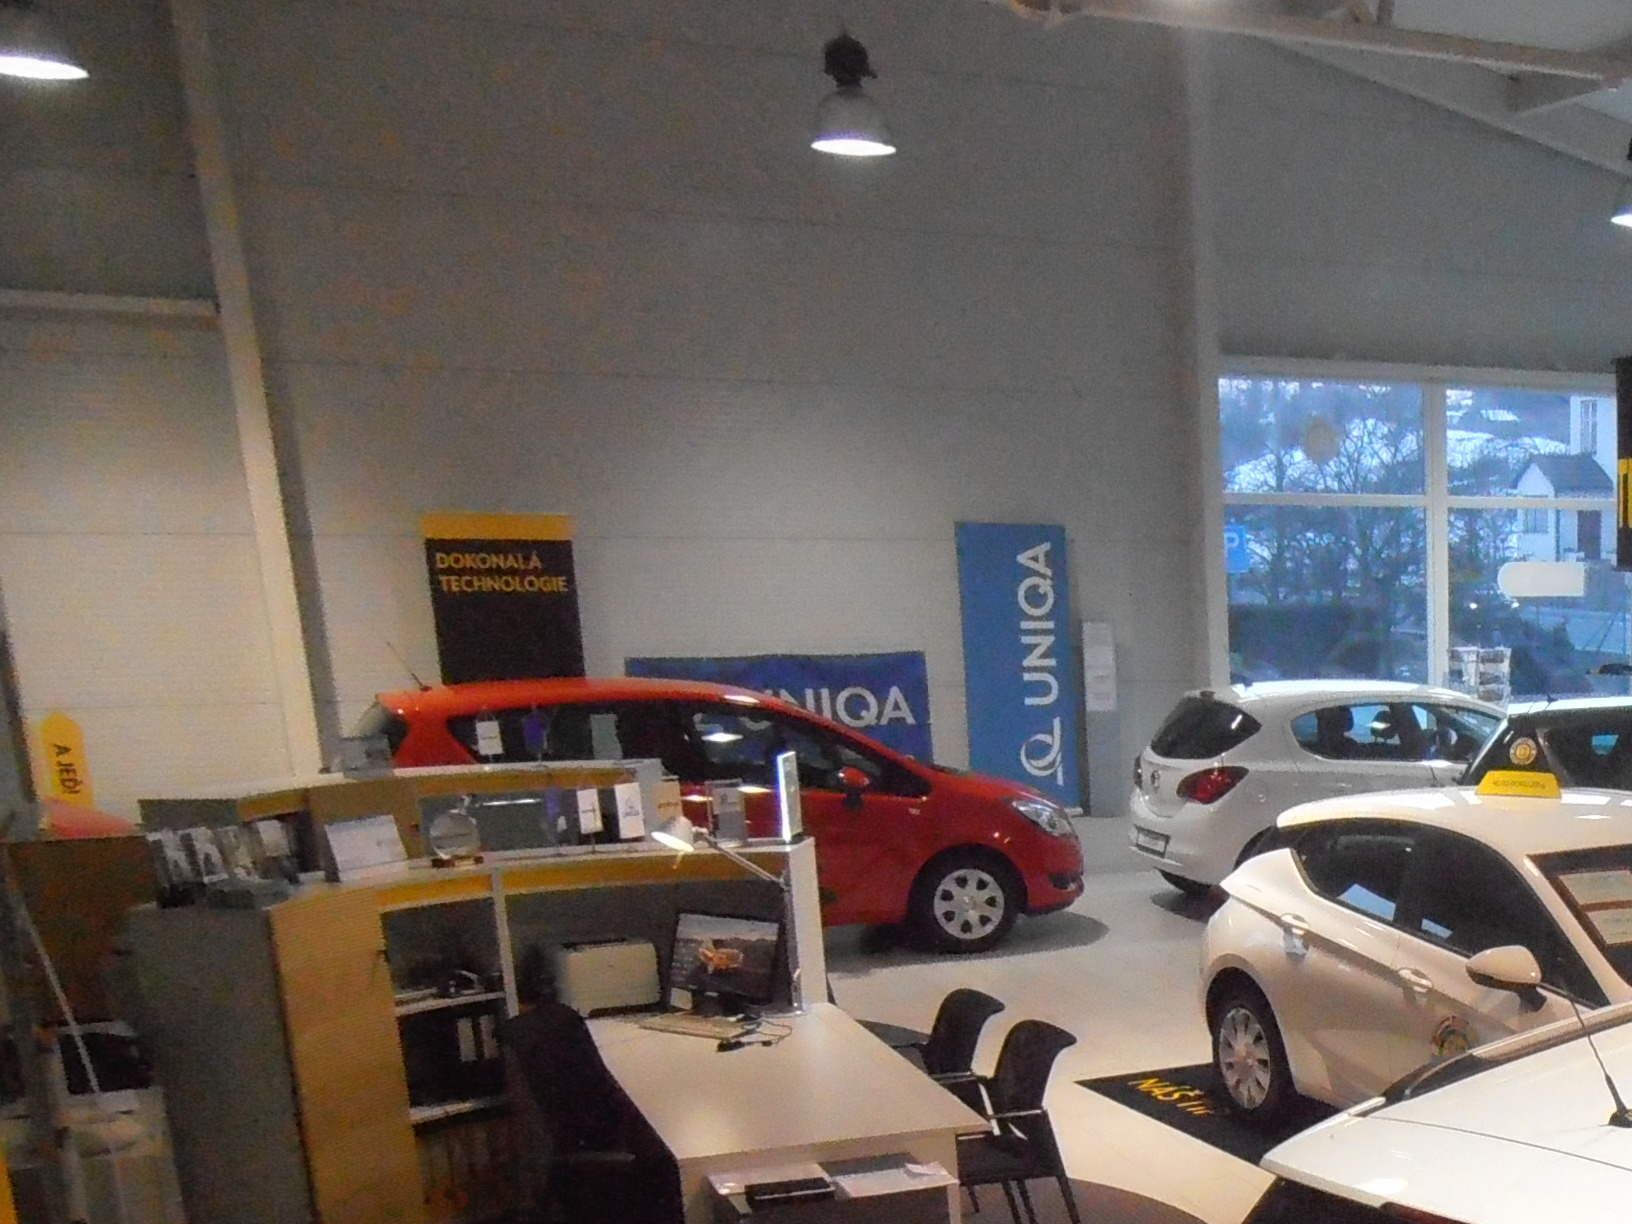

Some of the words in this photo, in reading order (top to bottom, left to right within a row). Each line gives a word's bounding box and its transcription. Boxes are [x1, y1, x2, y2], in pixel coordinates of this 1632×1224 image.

[435, 551, 543, 570] DOKONALÁ
[439, 575, 570, 592] TECHNOLOGIE
[1016, 541, 1060, 705] UNIQA
